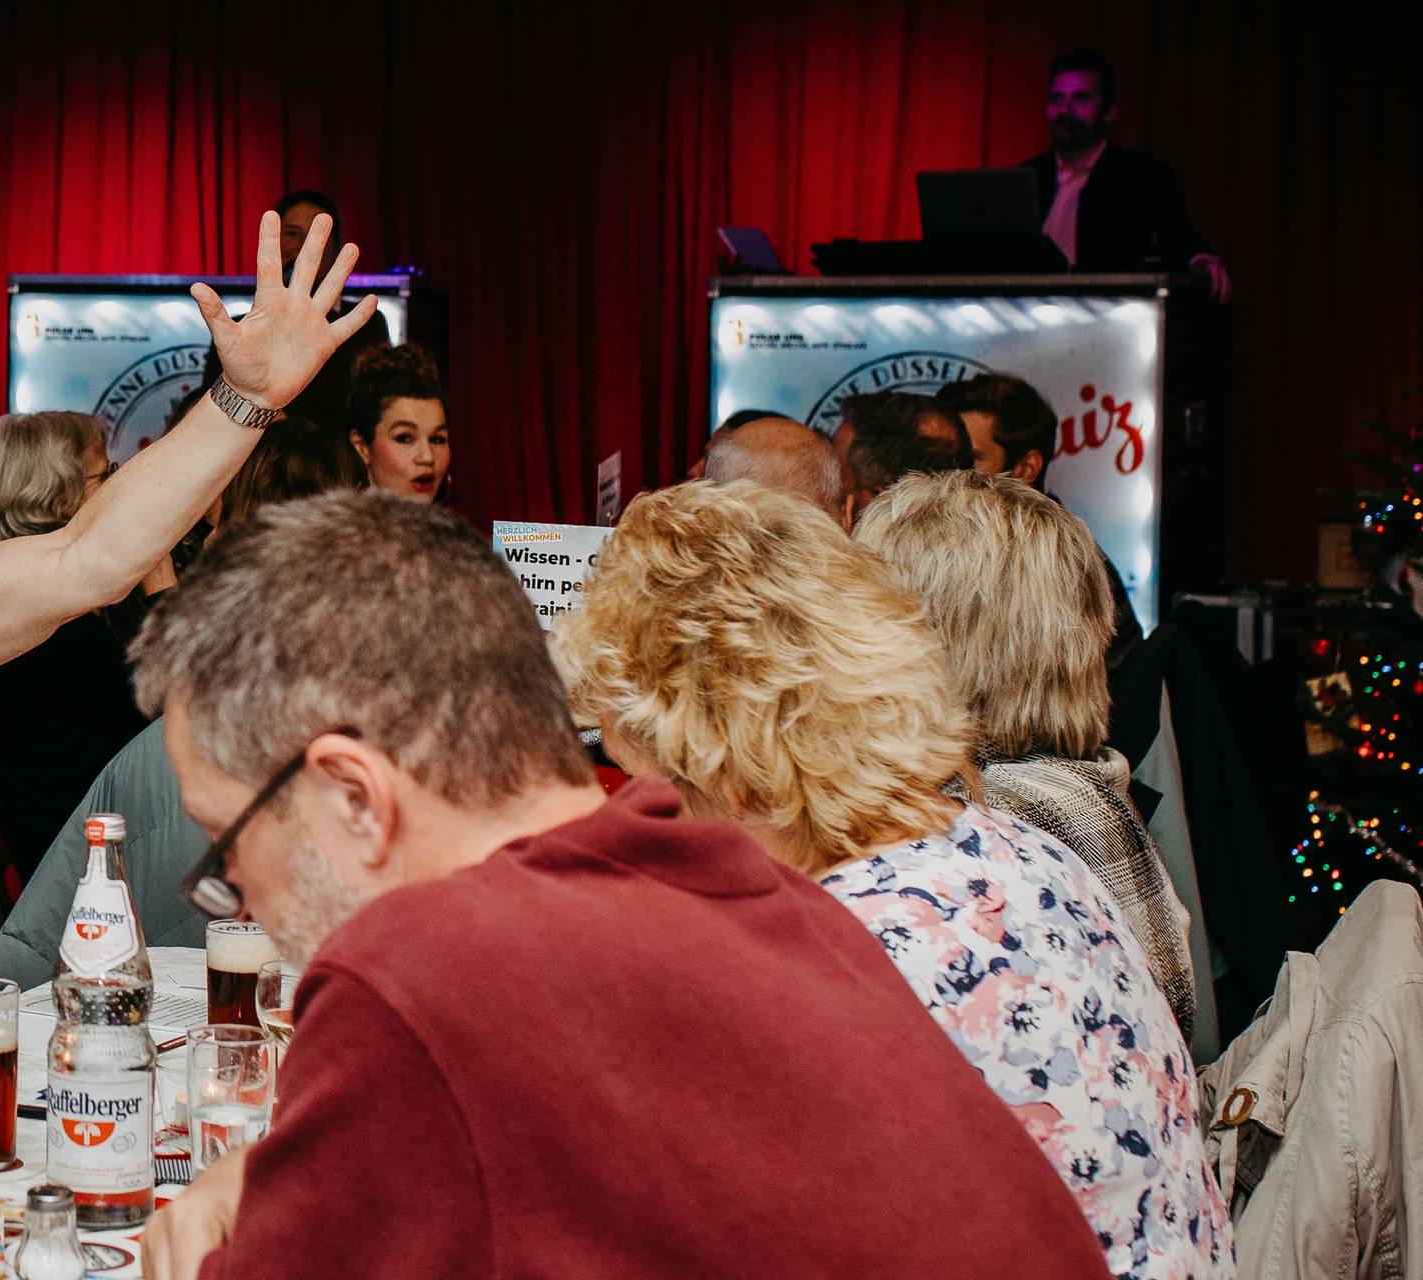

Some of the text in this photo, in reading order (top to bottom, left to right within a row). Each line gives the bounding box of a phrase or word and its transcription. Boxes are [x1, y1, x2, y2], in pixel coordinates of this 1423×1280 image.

[496, 526, 538, 535] HERZLICH
[502, 533, 562, 543] WILLKOMMEN
[504, 547, 570, 566] Wissen
[47, 1084, 143, 1122] Raffelberger
